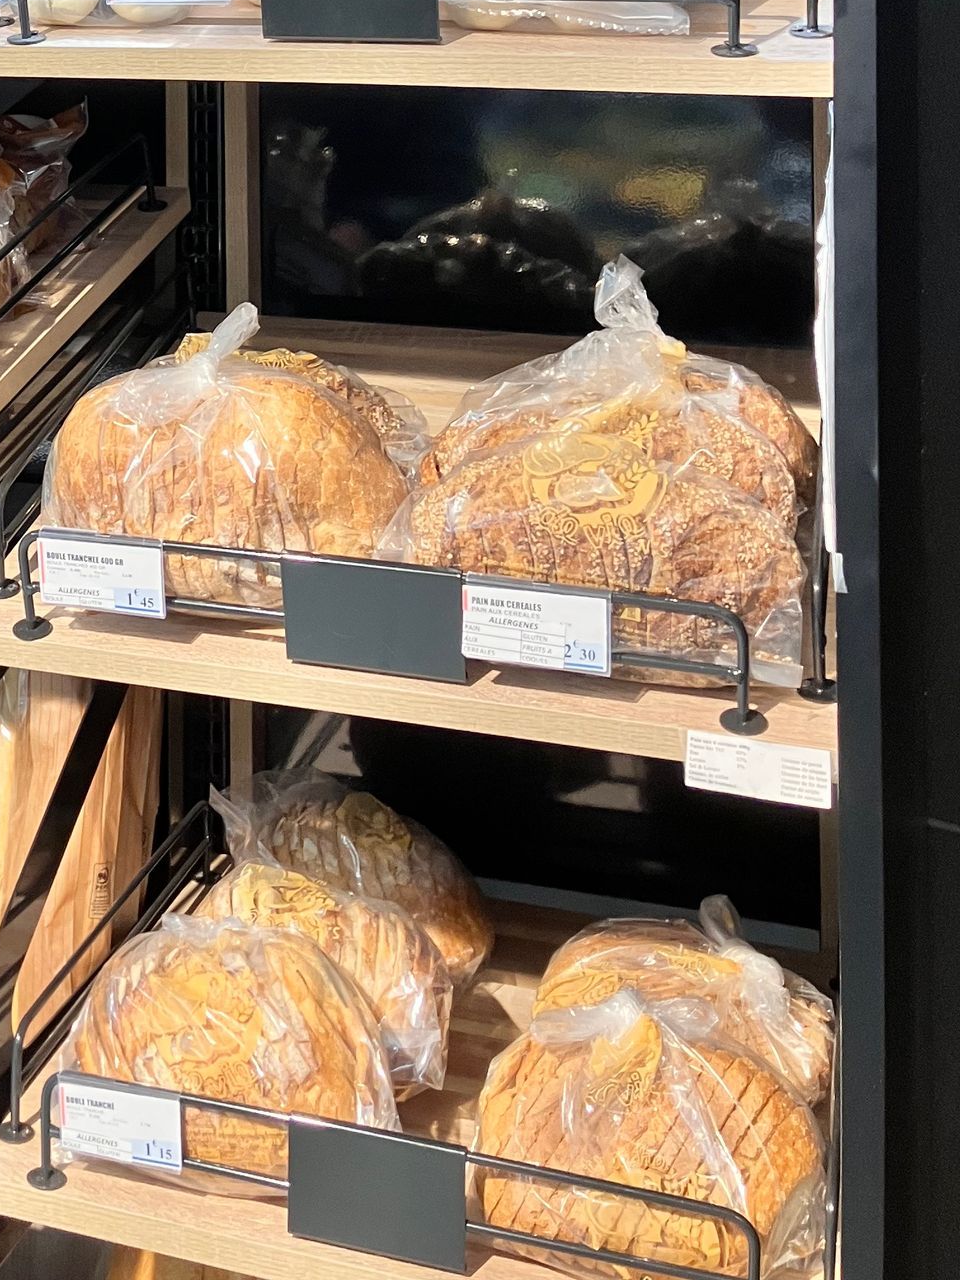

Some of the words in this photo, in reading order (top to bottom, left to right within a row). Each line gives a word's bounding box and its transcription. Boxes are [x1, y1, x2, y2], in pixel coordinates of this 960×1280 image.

[46, 552, 66, 560] BOULE
[68, 554, 99, 564] TRANCHEE
[100, 557, 114, 565] 400
[58, 587, 100, 597] ALLERGENES
[471, 596, 489, 606] PAIN
[490, 599, 505, 608] AUX
[506, 600, 542, 612] CEREALES
[504, 610, 540, 619] CEREALES
[489, 616, 539, 630] ALLERGENES
[464, 635, 478, 643] AUX
[523, 634, 548, 642] GLUTEN
[464, 646, 496, 656] CEREALES
[522, 645, 546, 653] FRUITS
[522, 655, 548, 664] COQUES
[77, 1133, 118, 1147] ALLERGENES
